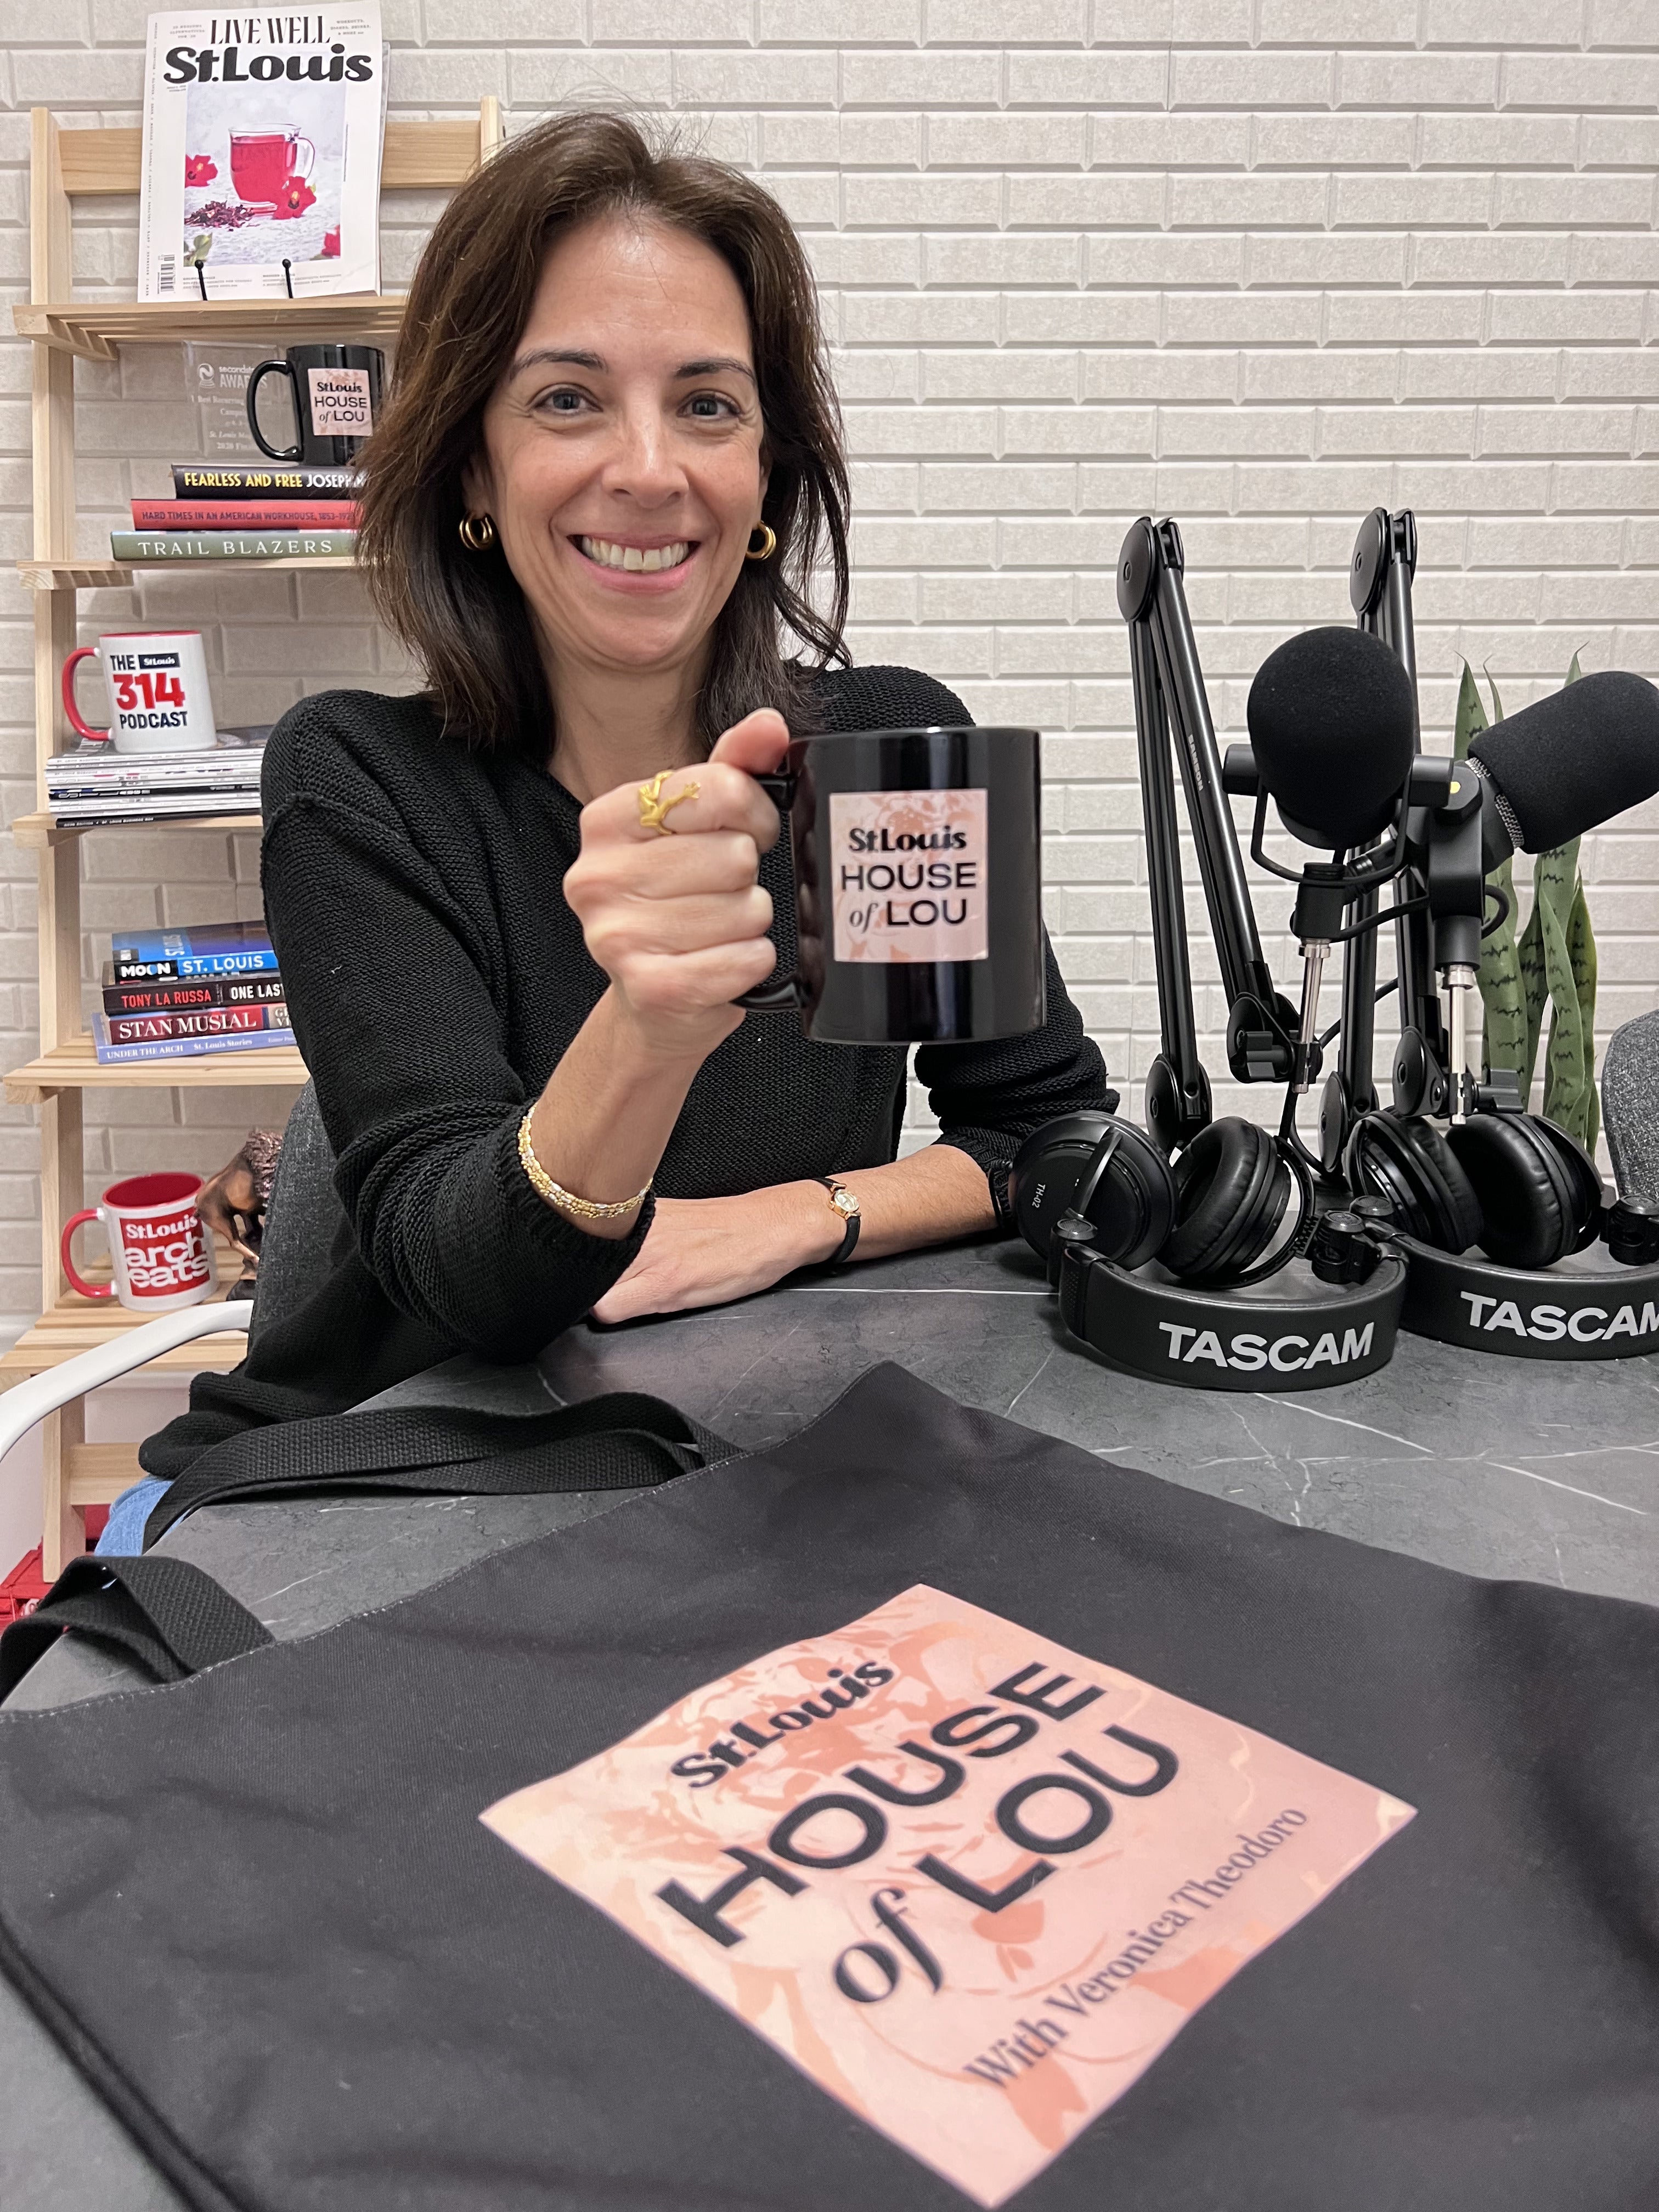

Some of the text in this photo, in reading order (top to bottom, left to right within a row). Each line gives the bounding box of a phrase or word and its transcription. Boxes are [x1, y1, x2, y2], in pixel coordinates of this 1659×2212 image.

[211, 18, 261, 44] LIVE
[267, 15, 330, 44] WELL
[314, 396, 368, 409] HOUSE
[319, 410, 365, 424] of LOU
[184, 472, 241, 487] FEARLESS
[245, 474, 272, 487] AND
[275, 474, 303, 488] FREE
[142, 511, 165, 520] HARD
[168, 511, 193, 520] TIMES
[195, 512, 204, 520] IN
[207, 512, 217, 520] AN
[220, 512, 262, 521] AMERICAN
[264, 512, 317, 521] WORKHOUSE,
[138, 540, 332, 555] TRAIL BLAZERS
[110, 654, 136, 671] THE
[113, 673, 185, 710] 314
[120, 711, 188, 730] PODCAST
[841, 862, 977, 891] HOUSE
[850, 899, 967, 934] of LOU
[120, 962, 171, 978] MOON
[182, 960, 207, 974] ST.
[214, 955, 264, 970] LOUIS
[121, 994, 151, 1008] TONY
[155, 992, 171, 1006] LA
[173, 989, 212, 1004] RUSSA
[230, 985, 254, 1000] ONE
[119, 1019, 173, 1039] STAN
[178, 1012, 257, 1034] MUSIAL
[106, 1049, 138, 1059] UNDER
[139, 1047, 156, 1056] THE
[159, 1045, 183, 1053] ARCH
[205, 1041, 226, 1049] Louis
[227, 1038, 252, 1047] Stories
[1032, 1183, 1046, 1208] TH-02
[125, 1231, 205, 1268] arch
[128, 1253, 209, 1289] eats
[1159, 1321, 1375, 1372] TASCAM
[653, 1661, 1108, 1949] HOUSE
[832, 1724, 1180, 2004] of LOU
[962, 1808, 1308, 2089] With Veronica Theodoro
